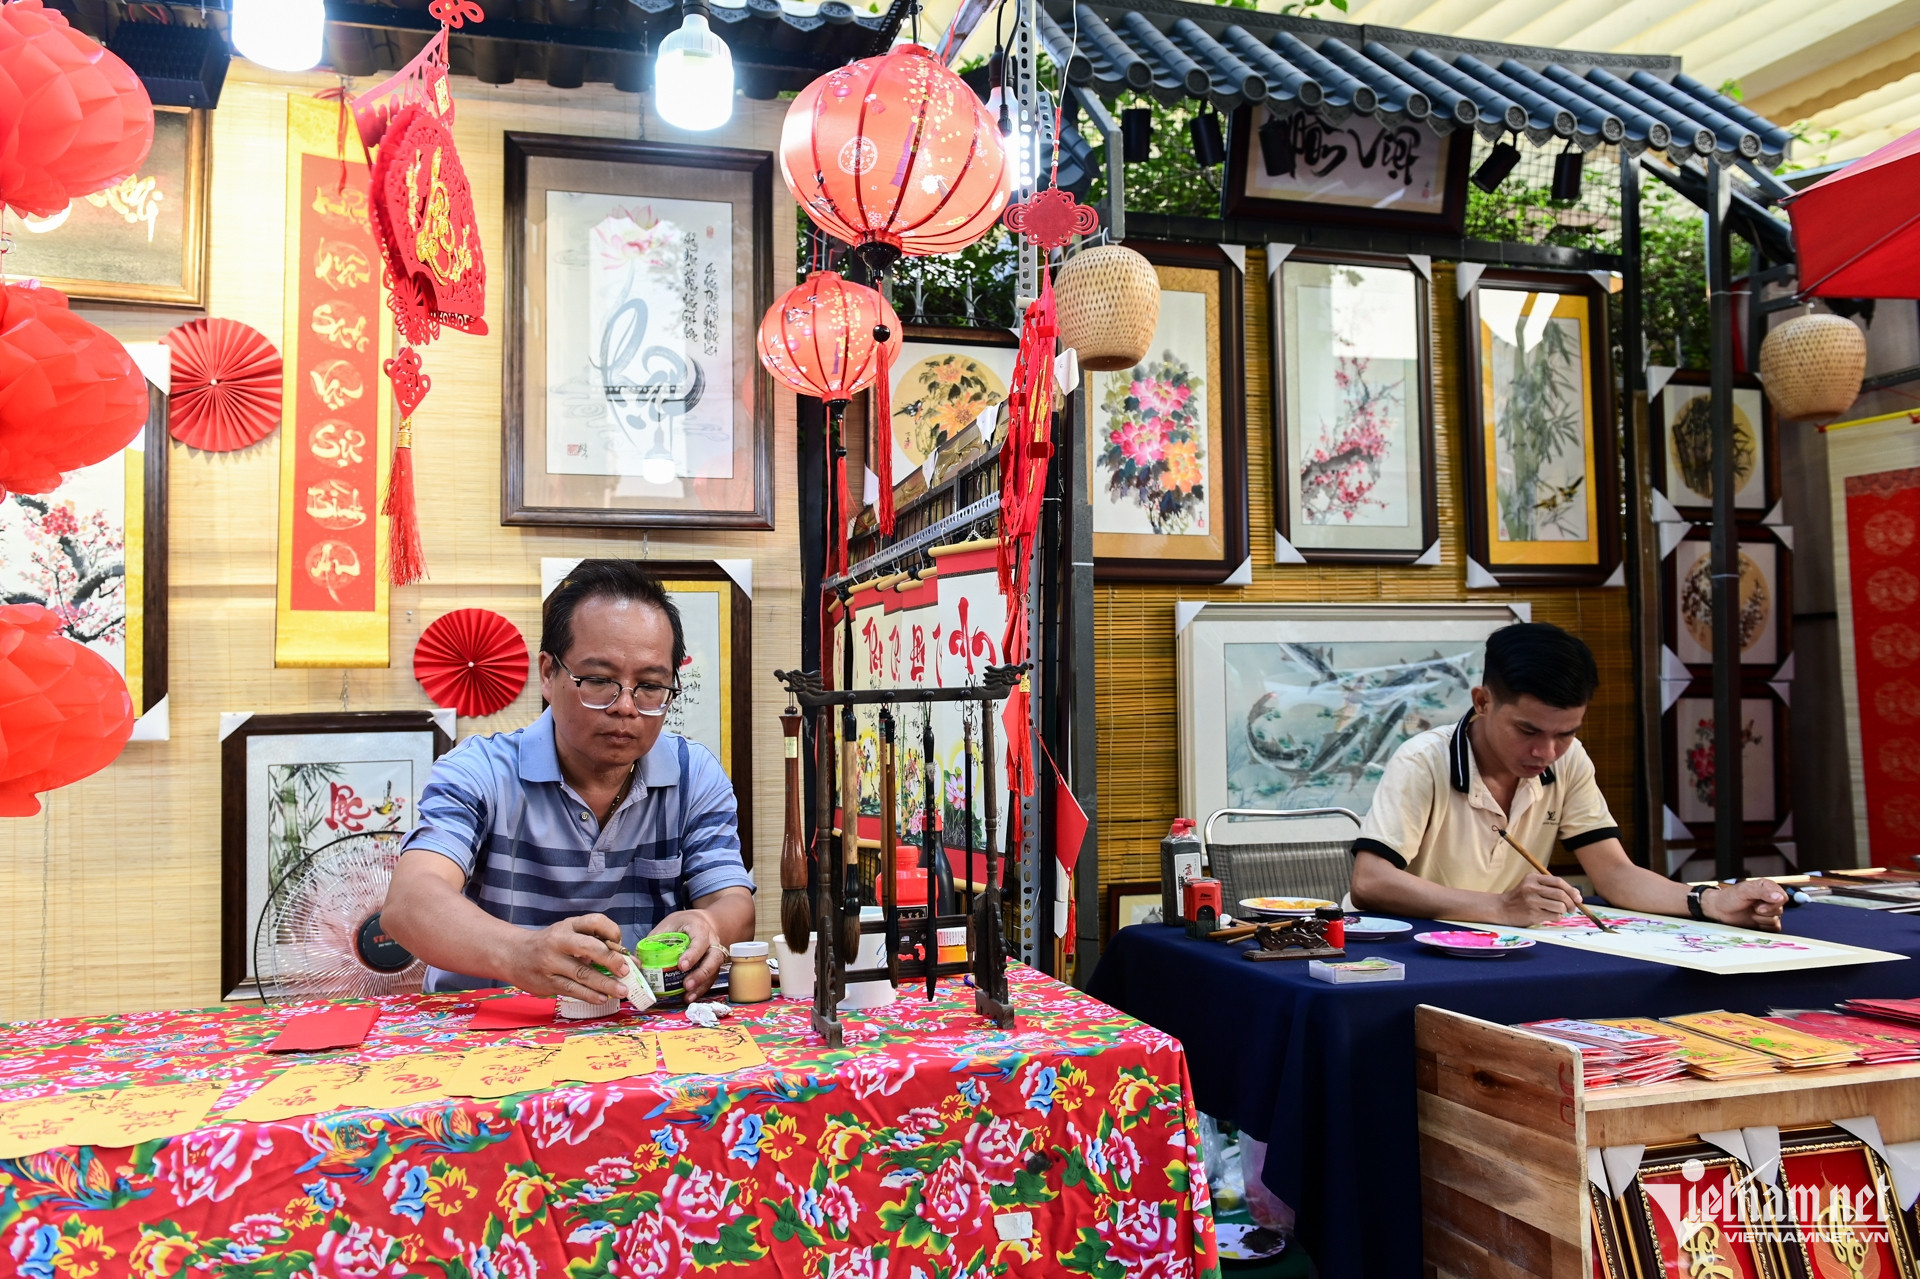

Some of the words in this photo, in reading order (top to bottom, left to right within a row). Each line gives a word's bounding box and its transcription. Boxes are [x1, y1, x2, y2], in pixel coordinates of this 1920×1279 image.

[1347, 126, 1421, 186] Việt
[311, 424, 366, 467] Sự
[306, 480, 367, 520] Bình
[311, 543, 361, 605] An
